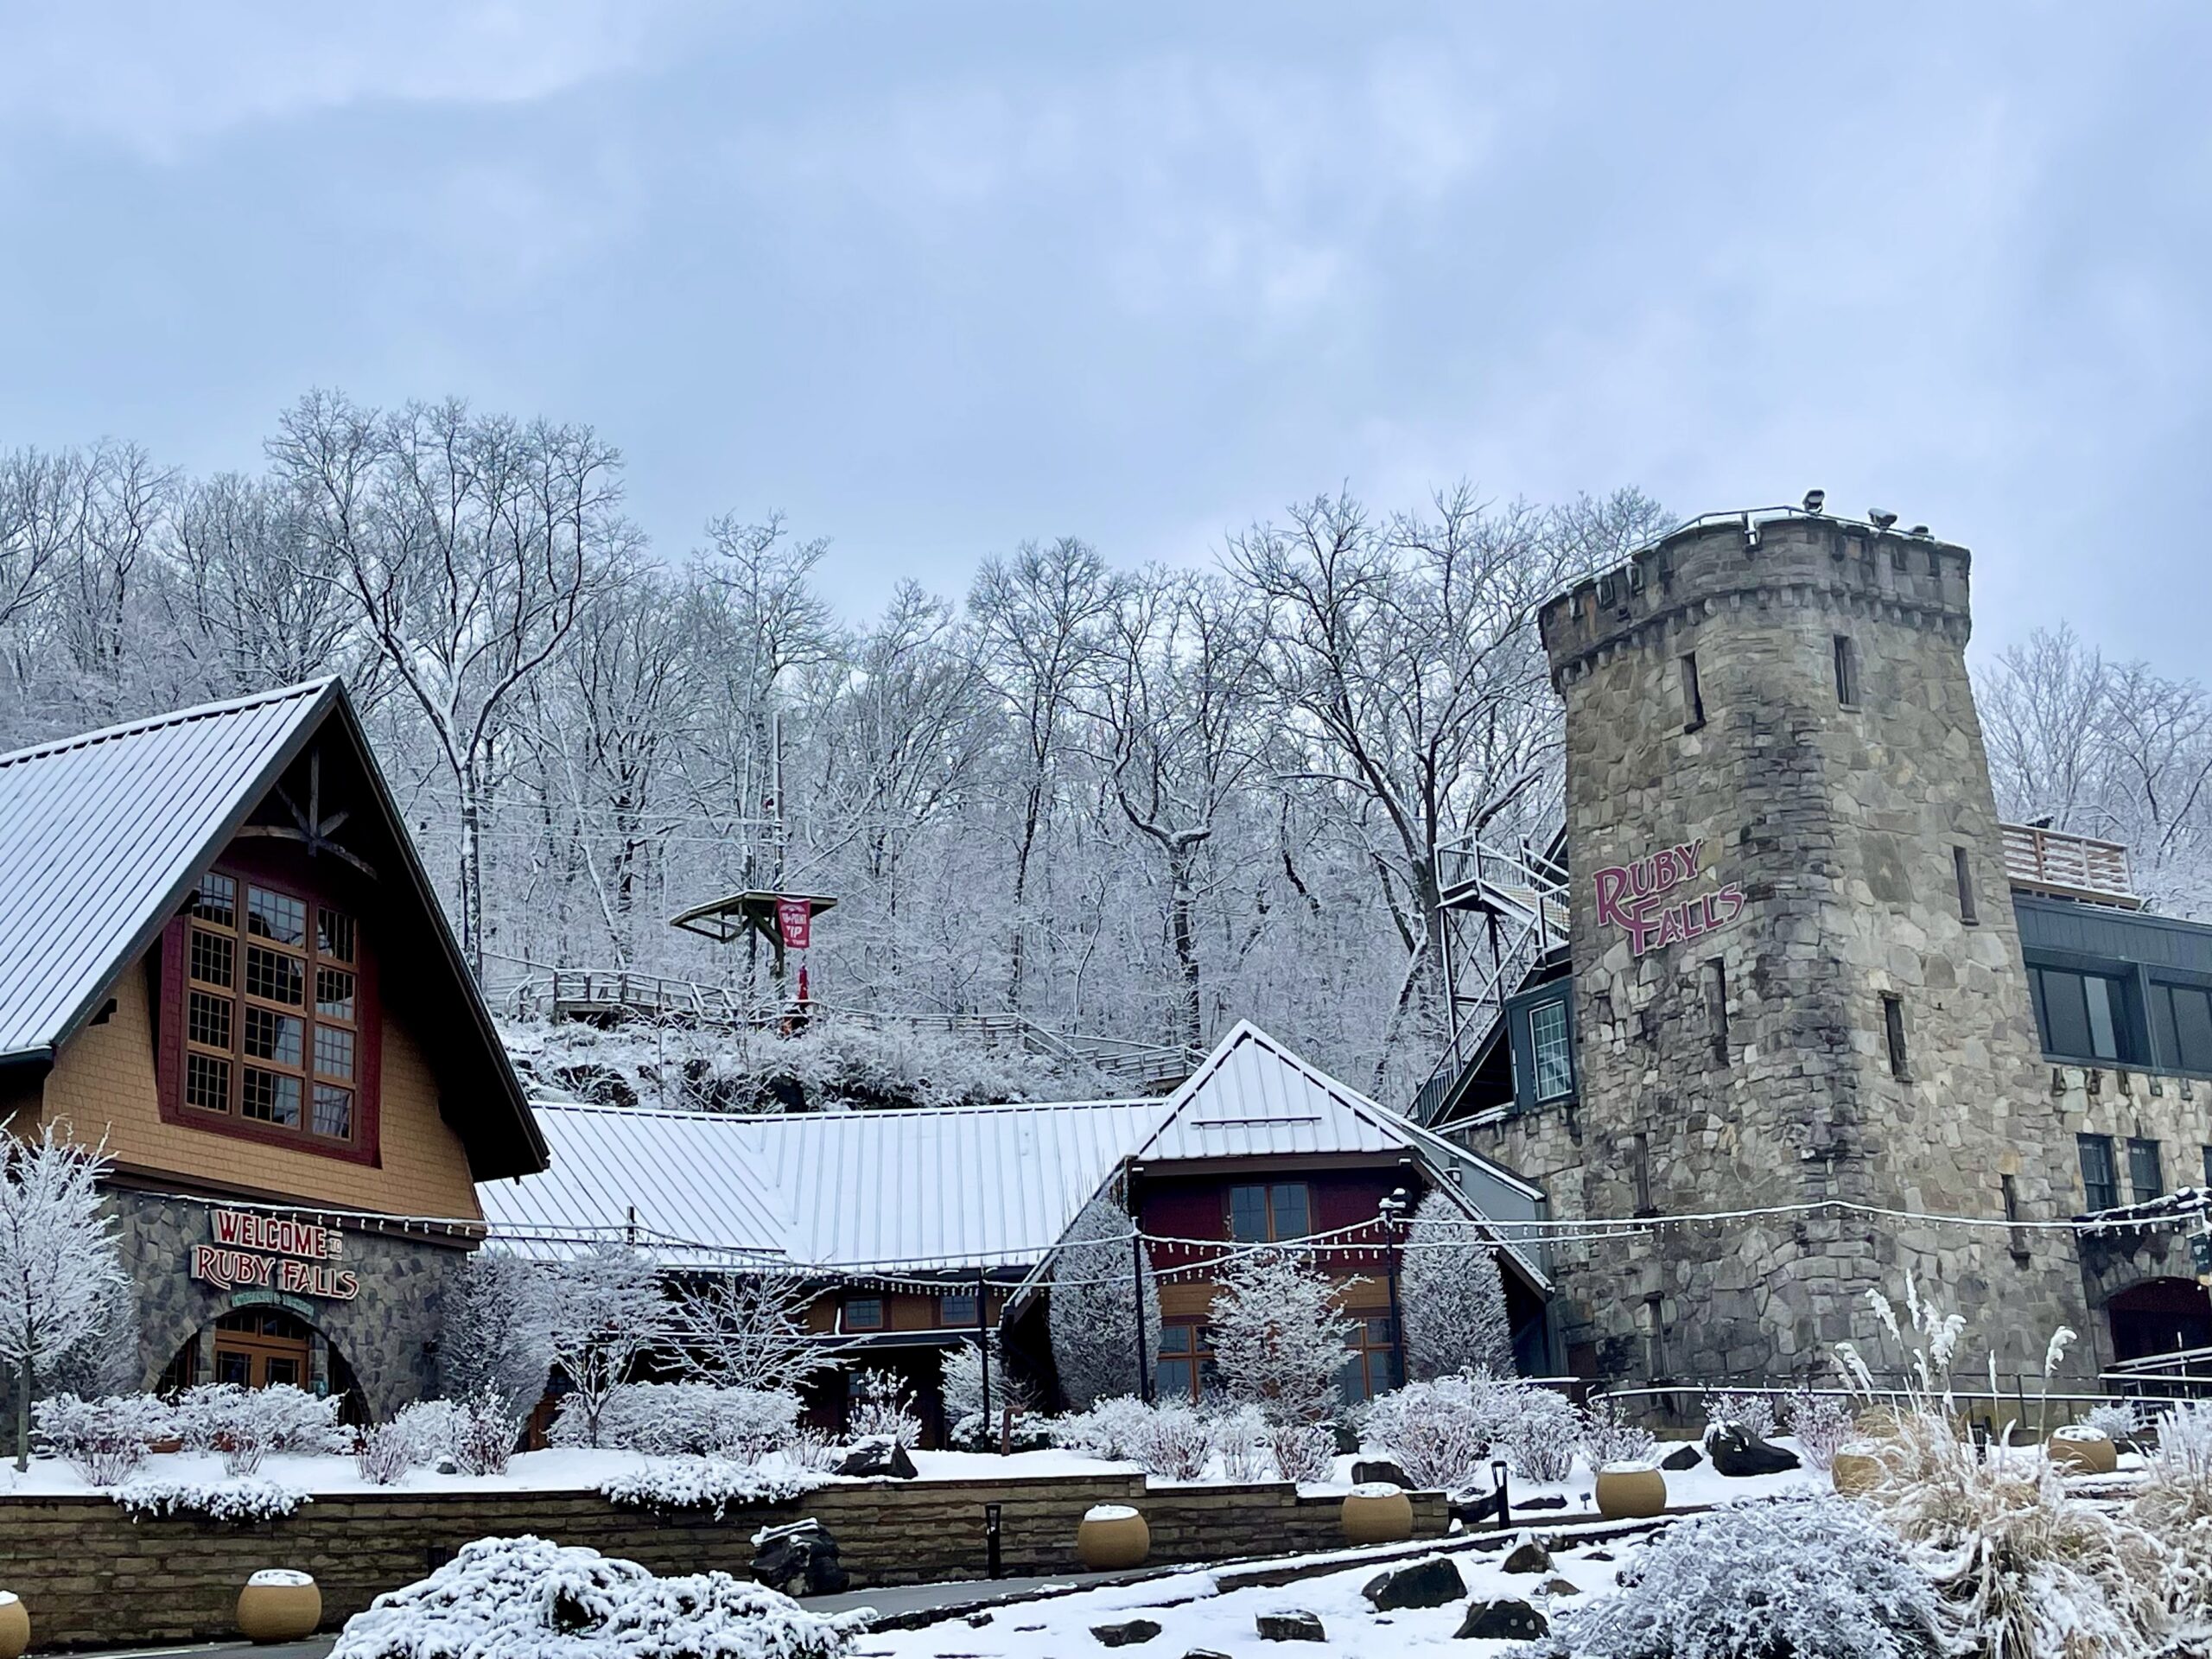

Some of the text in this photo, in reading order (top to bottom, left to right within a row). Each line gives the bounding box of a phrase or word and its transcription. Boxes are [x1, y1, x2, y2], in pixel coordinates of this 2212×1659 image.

[1592, 836, 1703, 929] RUBY
[1629, 881, 1745, 957] FALLS
[217, 1210, 342, 1259] WELCOME TO
[196, 1245, 359, 1300] RUBY FALLS
